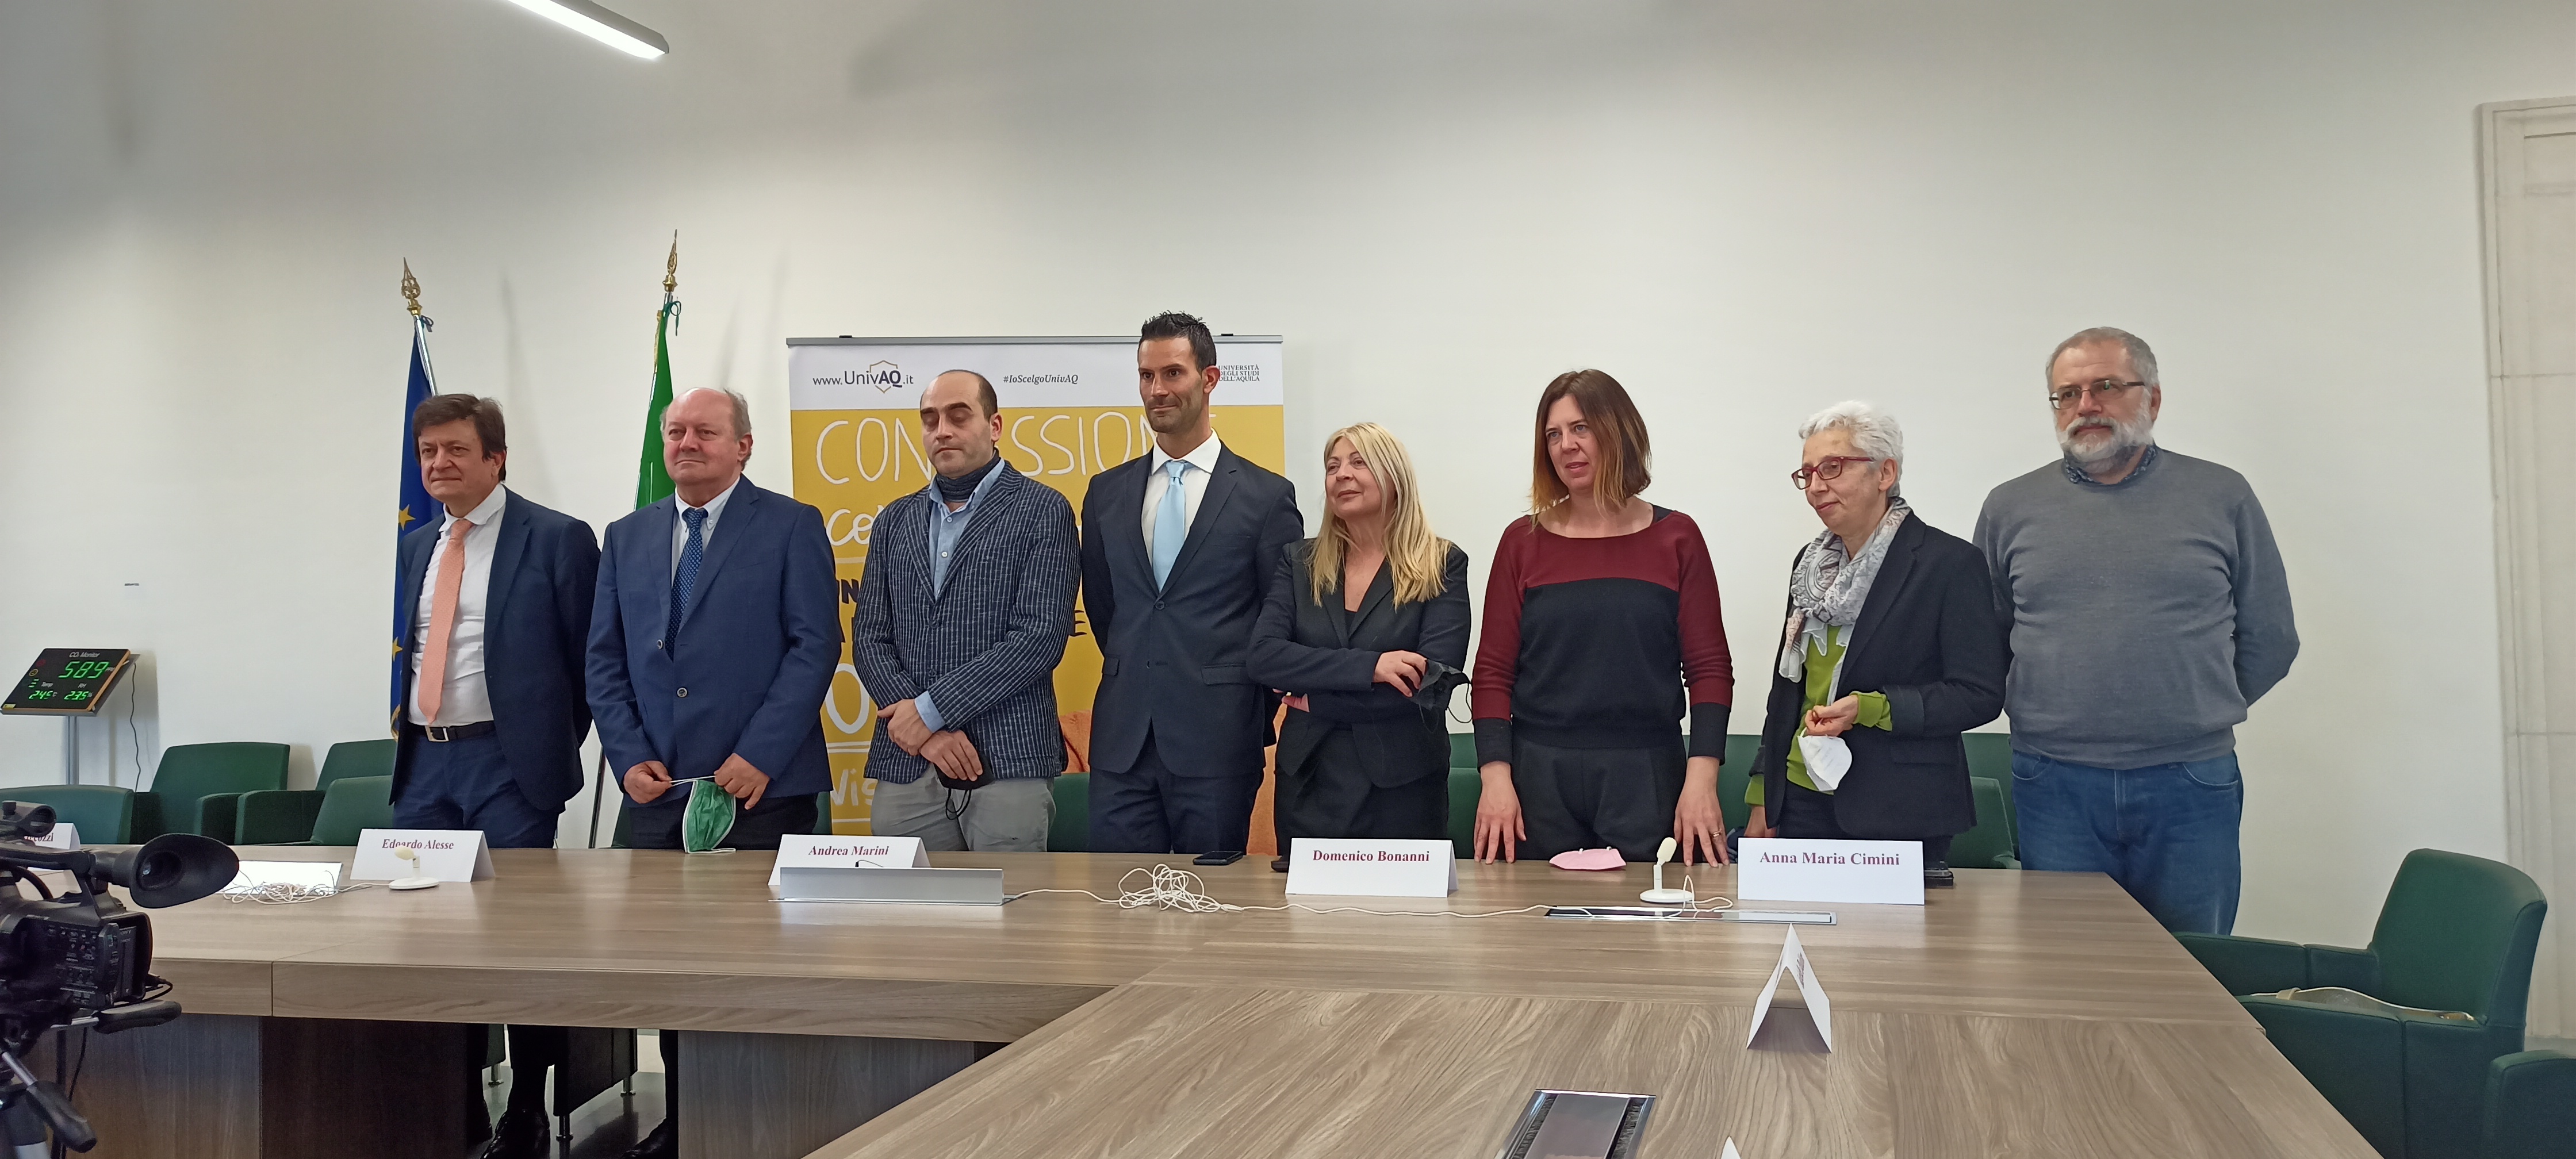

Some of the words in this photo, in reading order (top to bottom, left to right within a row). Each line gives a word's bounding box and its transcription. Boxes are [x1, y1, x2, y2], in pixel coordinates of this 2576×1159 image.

[812, 370, 914, 387] www.UnivAQ.it
[1003, 374, 1079, 385] #IoScelgoUnivAQ
[58, 661, 109, 678] 589
[424, 839, 454, 850] Alesse
[808, 846, 848, 856] Andrea
[851, 846, 890, 856] Marini
[1313, 850, 1373, 861] Domenico
[1378, 850, 1429, 862] Bonanni
[1760, 851, 1797, 864] Anna
[1803, 852, 1846, 865] Maria
[1850, 853, 1900, 865] Cimini
